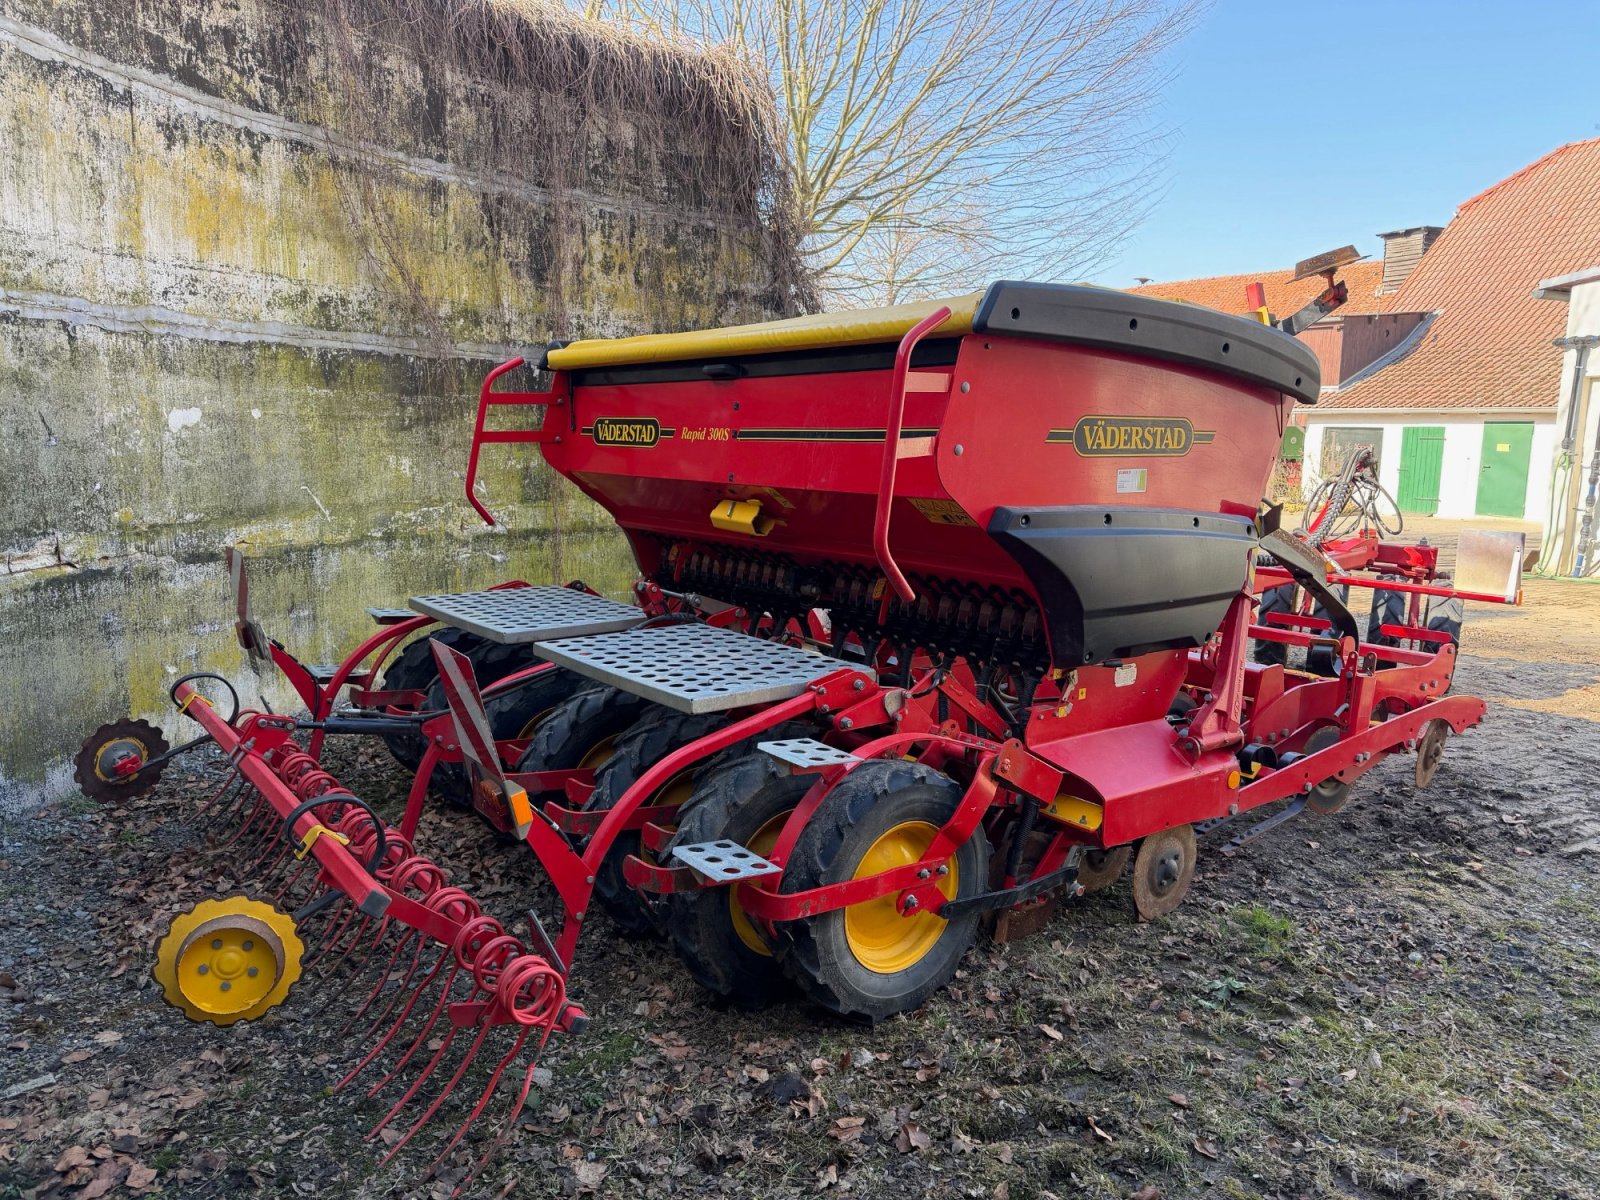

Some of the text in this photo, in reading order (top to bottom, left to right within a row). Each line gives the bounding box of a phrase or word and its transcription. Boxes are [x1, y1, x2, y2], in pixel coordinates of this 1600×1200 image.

[597, 420, 656, 443] VÄDERSTAD
[681, 427, 731, 443] Rapid 300S
[1083, 420, 1186, 450] VÄDERSTAD
